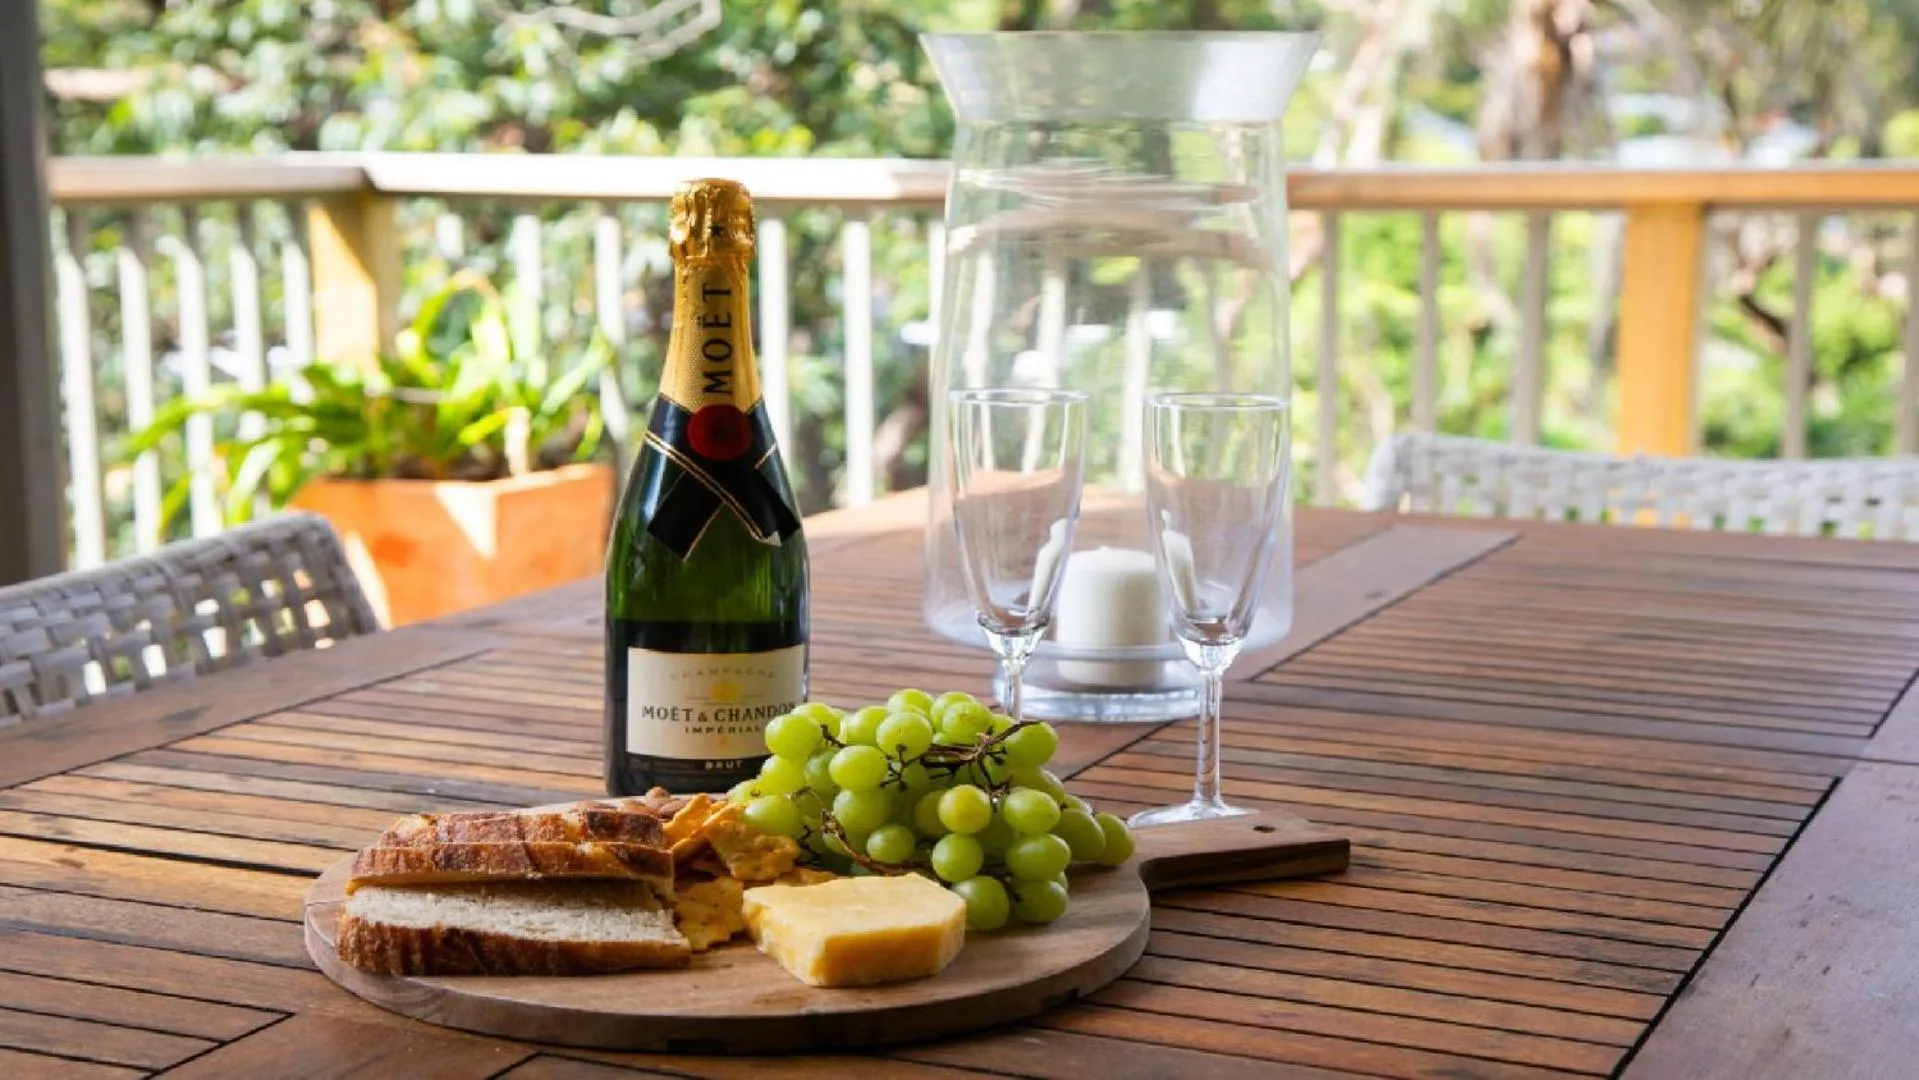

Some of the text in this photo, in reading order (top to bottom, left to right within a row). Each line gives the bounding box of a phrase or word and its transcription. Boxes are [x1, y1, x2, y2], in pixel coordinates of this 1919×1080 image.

[696, 282, 733, 397] MOËT
[669, 666, 775, 682] CHAMPAGNE
[641, 704, 695, 722] MOËT
[697, 710, 709, 722] &
[704, 760, 743, 770] BRUT
